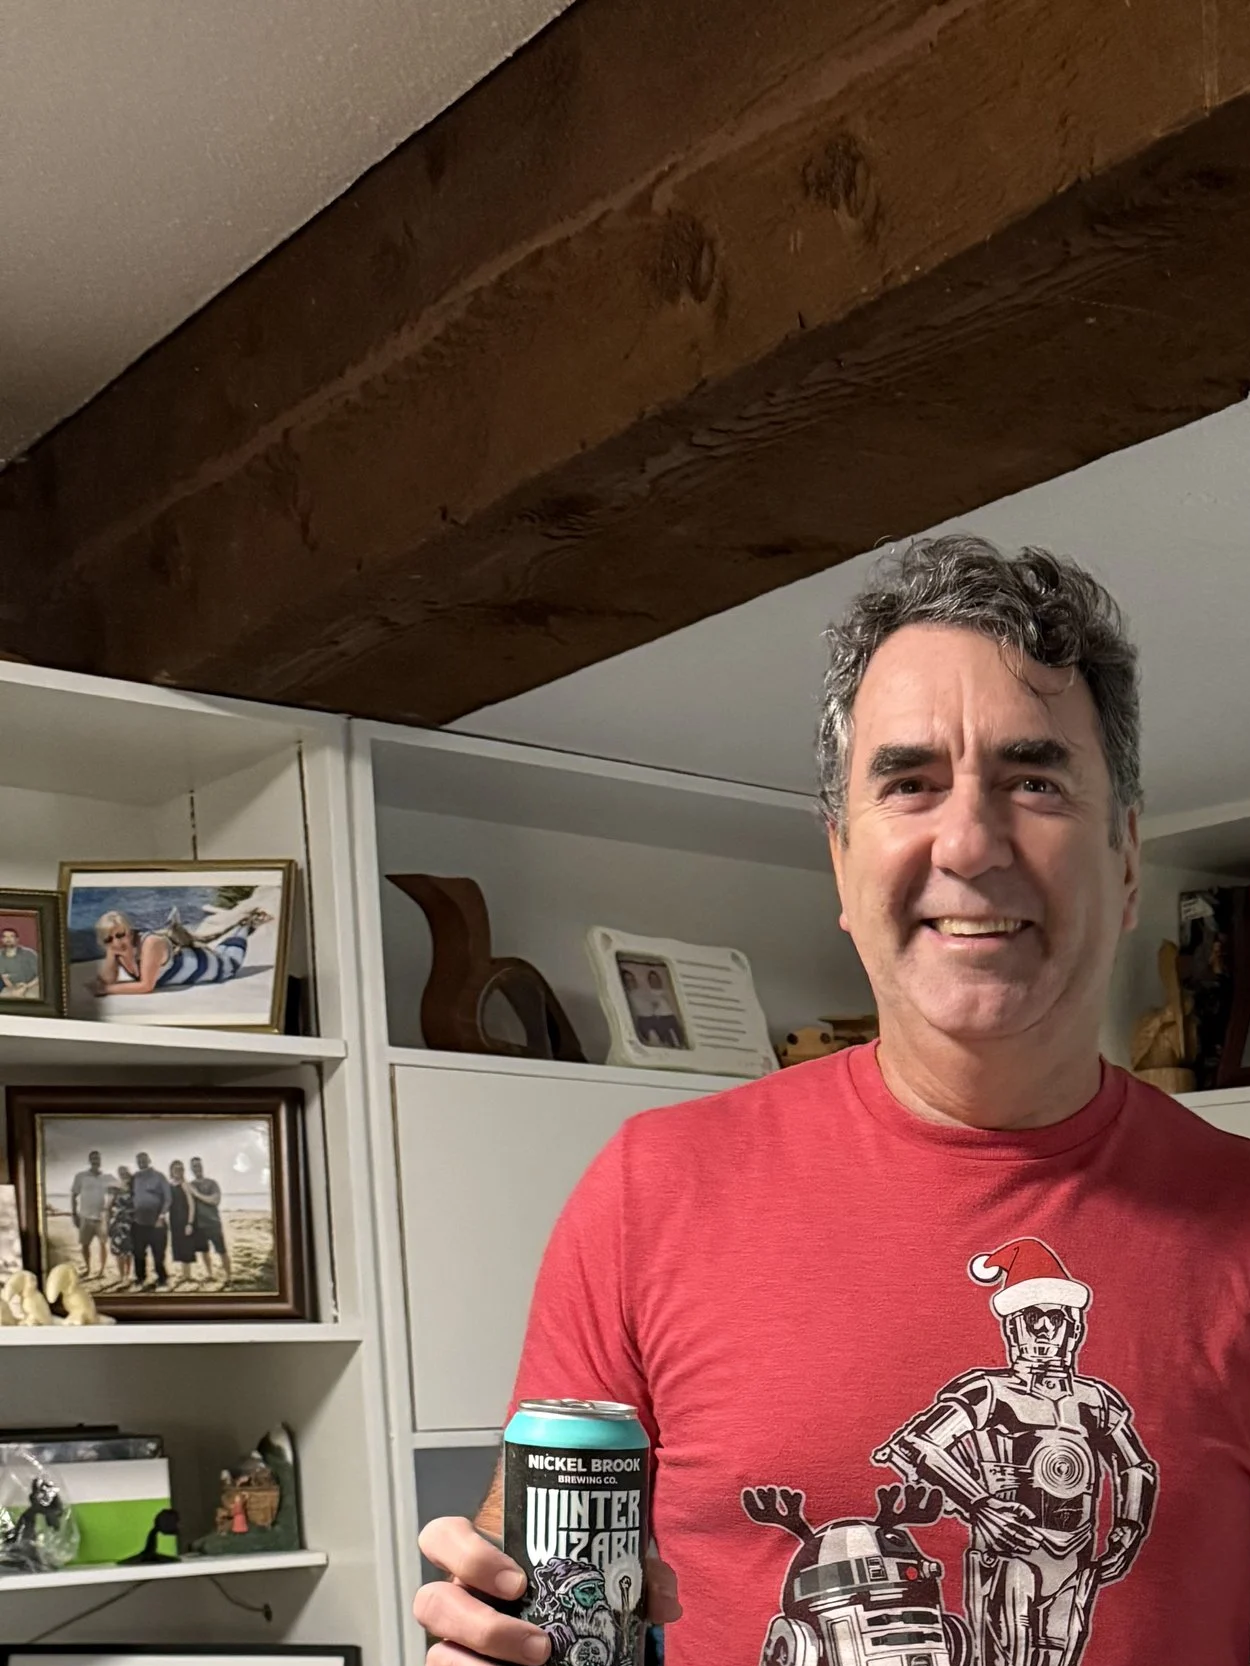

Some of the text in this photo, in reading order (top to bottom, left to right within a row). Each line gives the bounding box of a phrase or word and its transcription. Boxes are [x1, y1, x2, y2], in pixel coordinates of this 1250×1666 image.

[528, 1454, 640, 1473] NICKEL BROOK
[558, 1475, 618, 1485] BREWING CO.
[527, 1487, 640, 1560] WINTER
